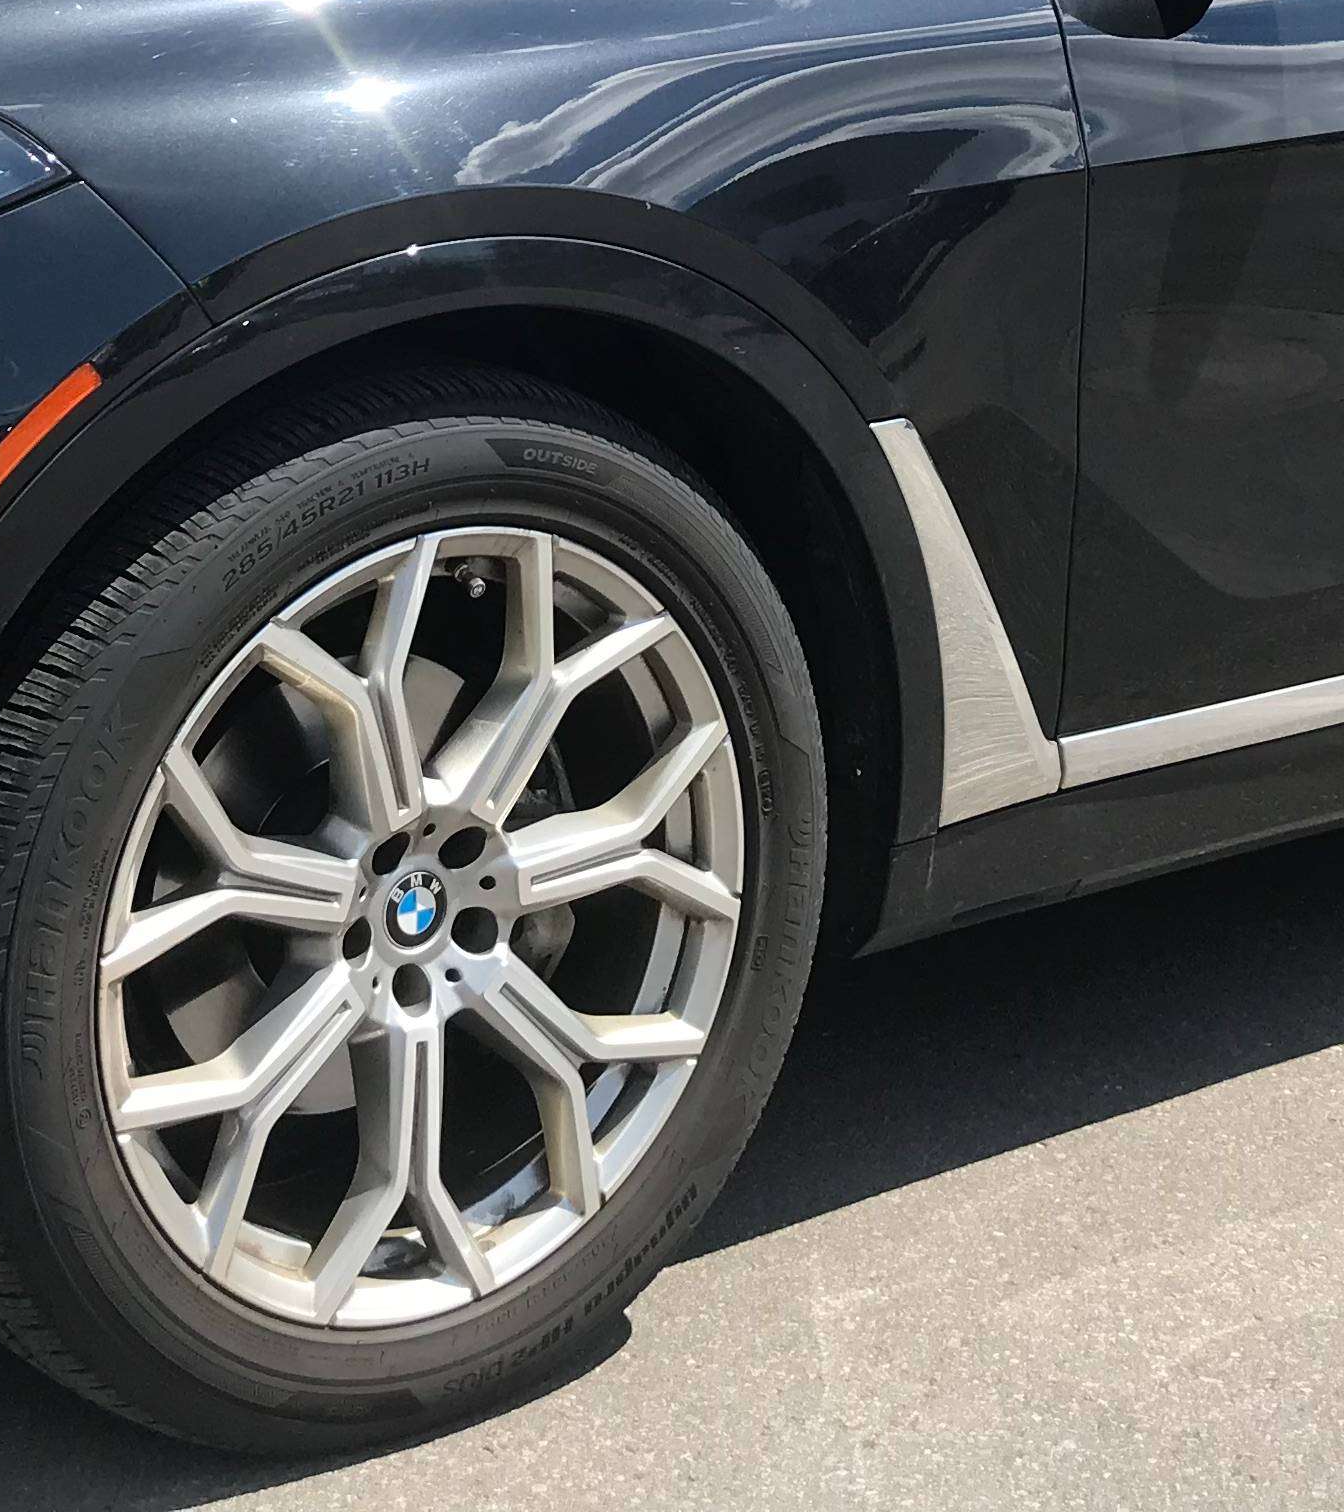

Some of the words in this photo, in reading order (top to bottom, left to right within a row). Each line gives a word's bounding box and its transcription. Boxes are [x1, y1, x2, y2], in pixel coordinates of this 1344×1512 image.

[521, 446, 600, 476] OUTSIDE
[220, 474, 368, 594] 285/45R21
[373, 456, 432, 490] 113H
[390, 873, 443, 904] BMW
